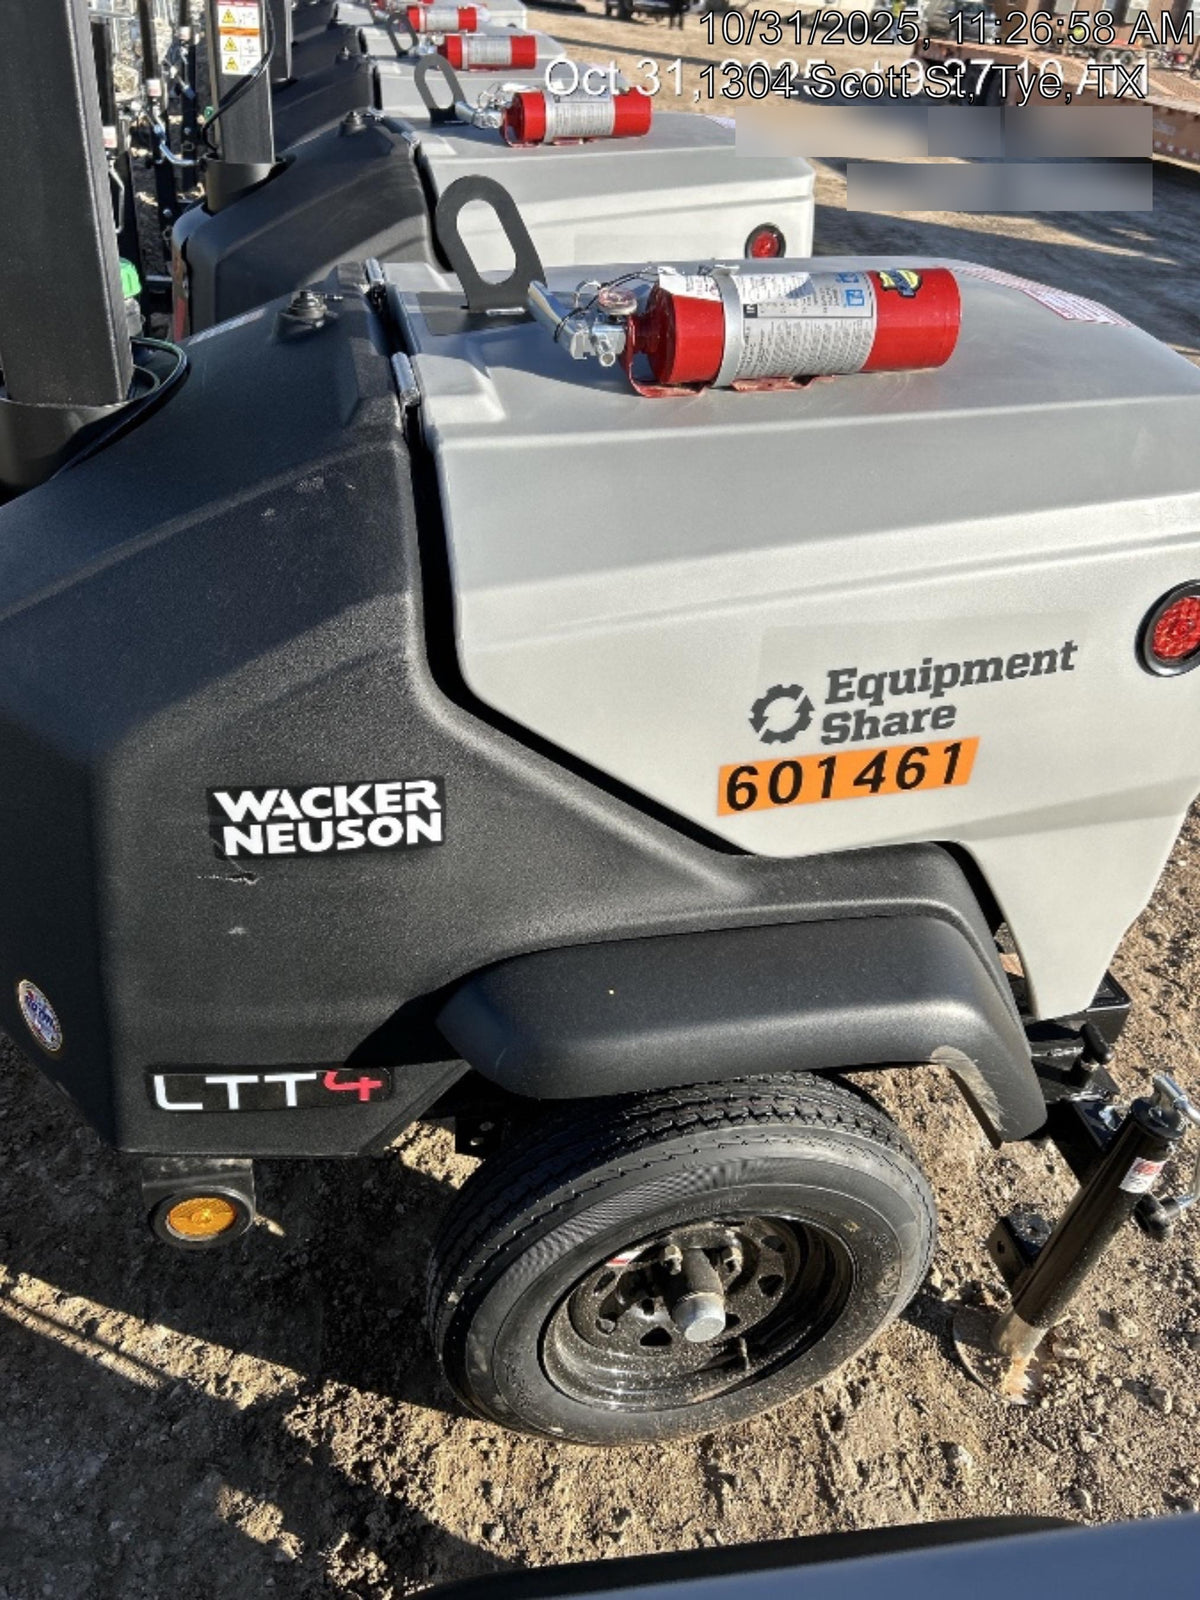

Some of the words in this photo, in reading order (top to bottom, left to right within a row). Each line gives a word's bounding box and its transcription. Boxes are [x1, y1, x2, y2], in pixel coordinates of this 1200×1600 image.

[824, 640, 1078, 706] Equipment
[821, 704, 957, 745] Share
[726, 742, 962, 811] 601461
[213, 780, 442, 822] WACKER
[223, 812, 442, 856] NEUSON
[153, 1070, 383, 1110] LTT4
